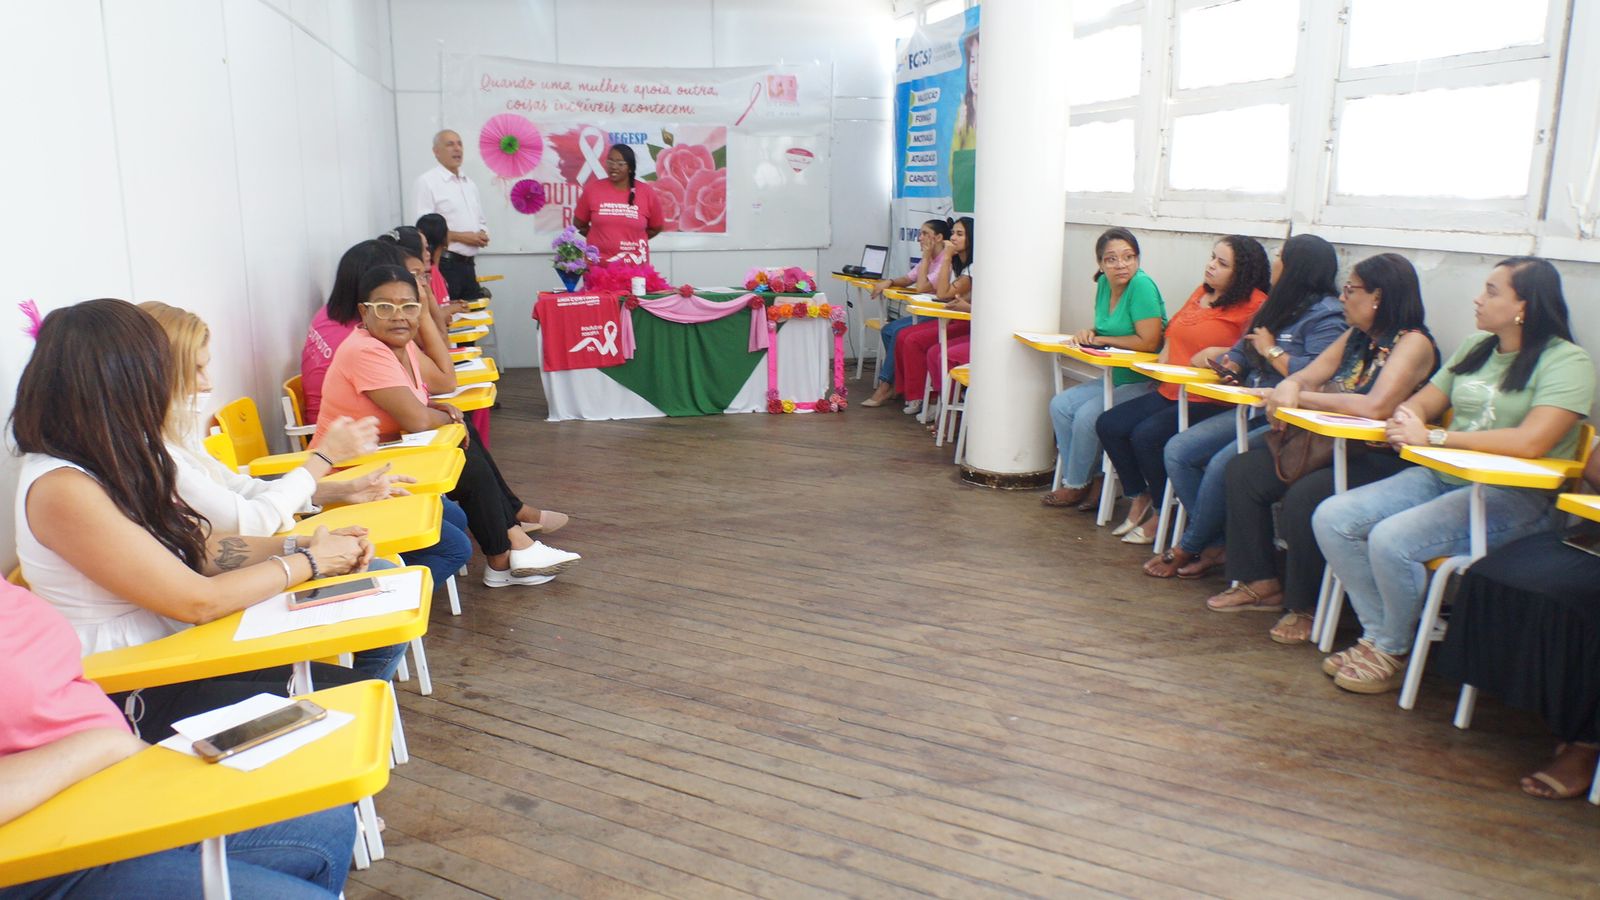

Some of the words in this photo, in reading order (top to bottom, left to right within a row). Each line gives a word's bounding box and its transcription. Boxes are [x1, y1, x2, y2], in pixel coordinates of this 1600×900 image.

[480, 73, 535, 92] Quando
[541, 81, 572, 91] uma
[578, 78, 629, 94] mulher
[634, 84, 672, 99] apoia
[506, 99, 547, 112] coisas
[554, 98, 617, 114] incríveis
[622, 102, 695, 115] acontecem.
[608, 132, 648, 144] SEGESP
